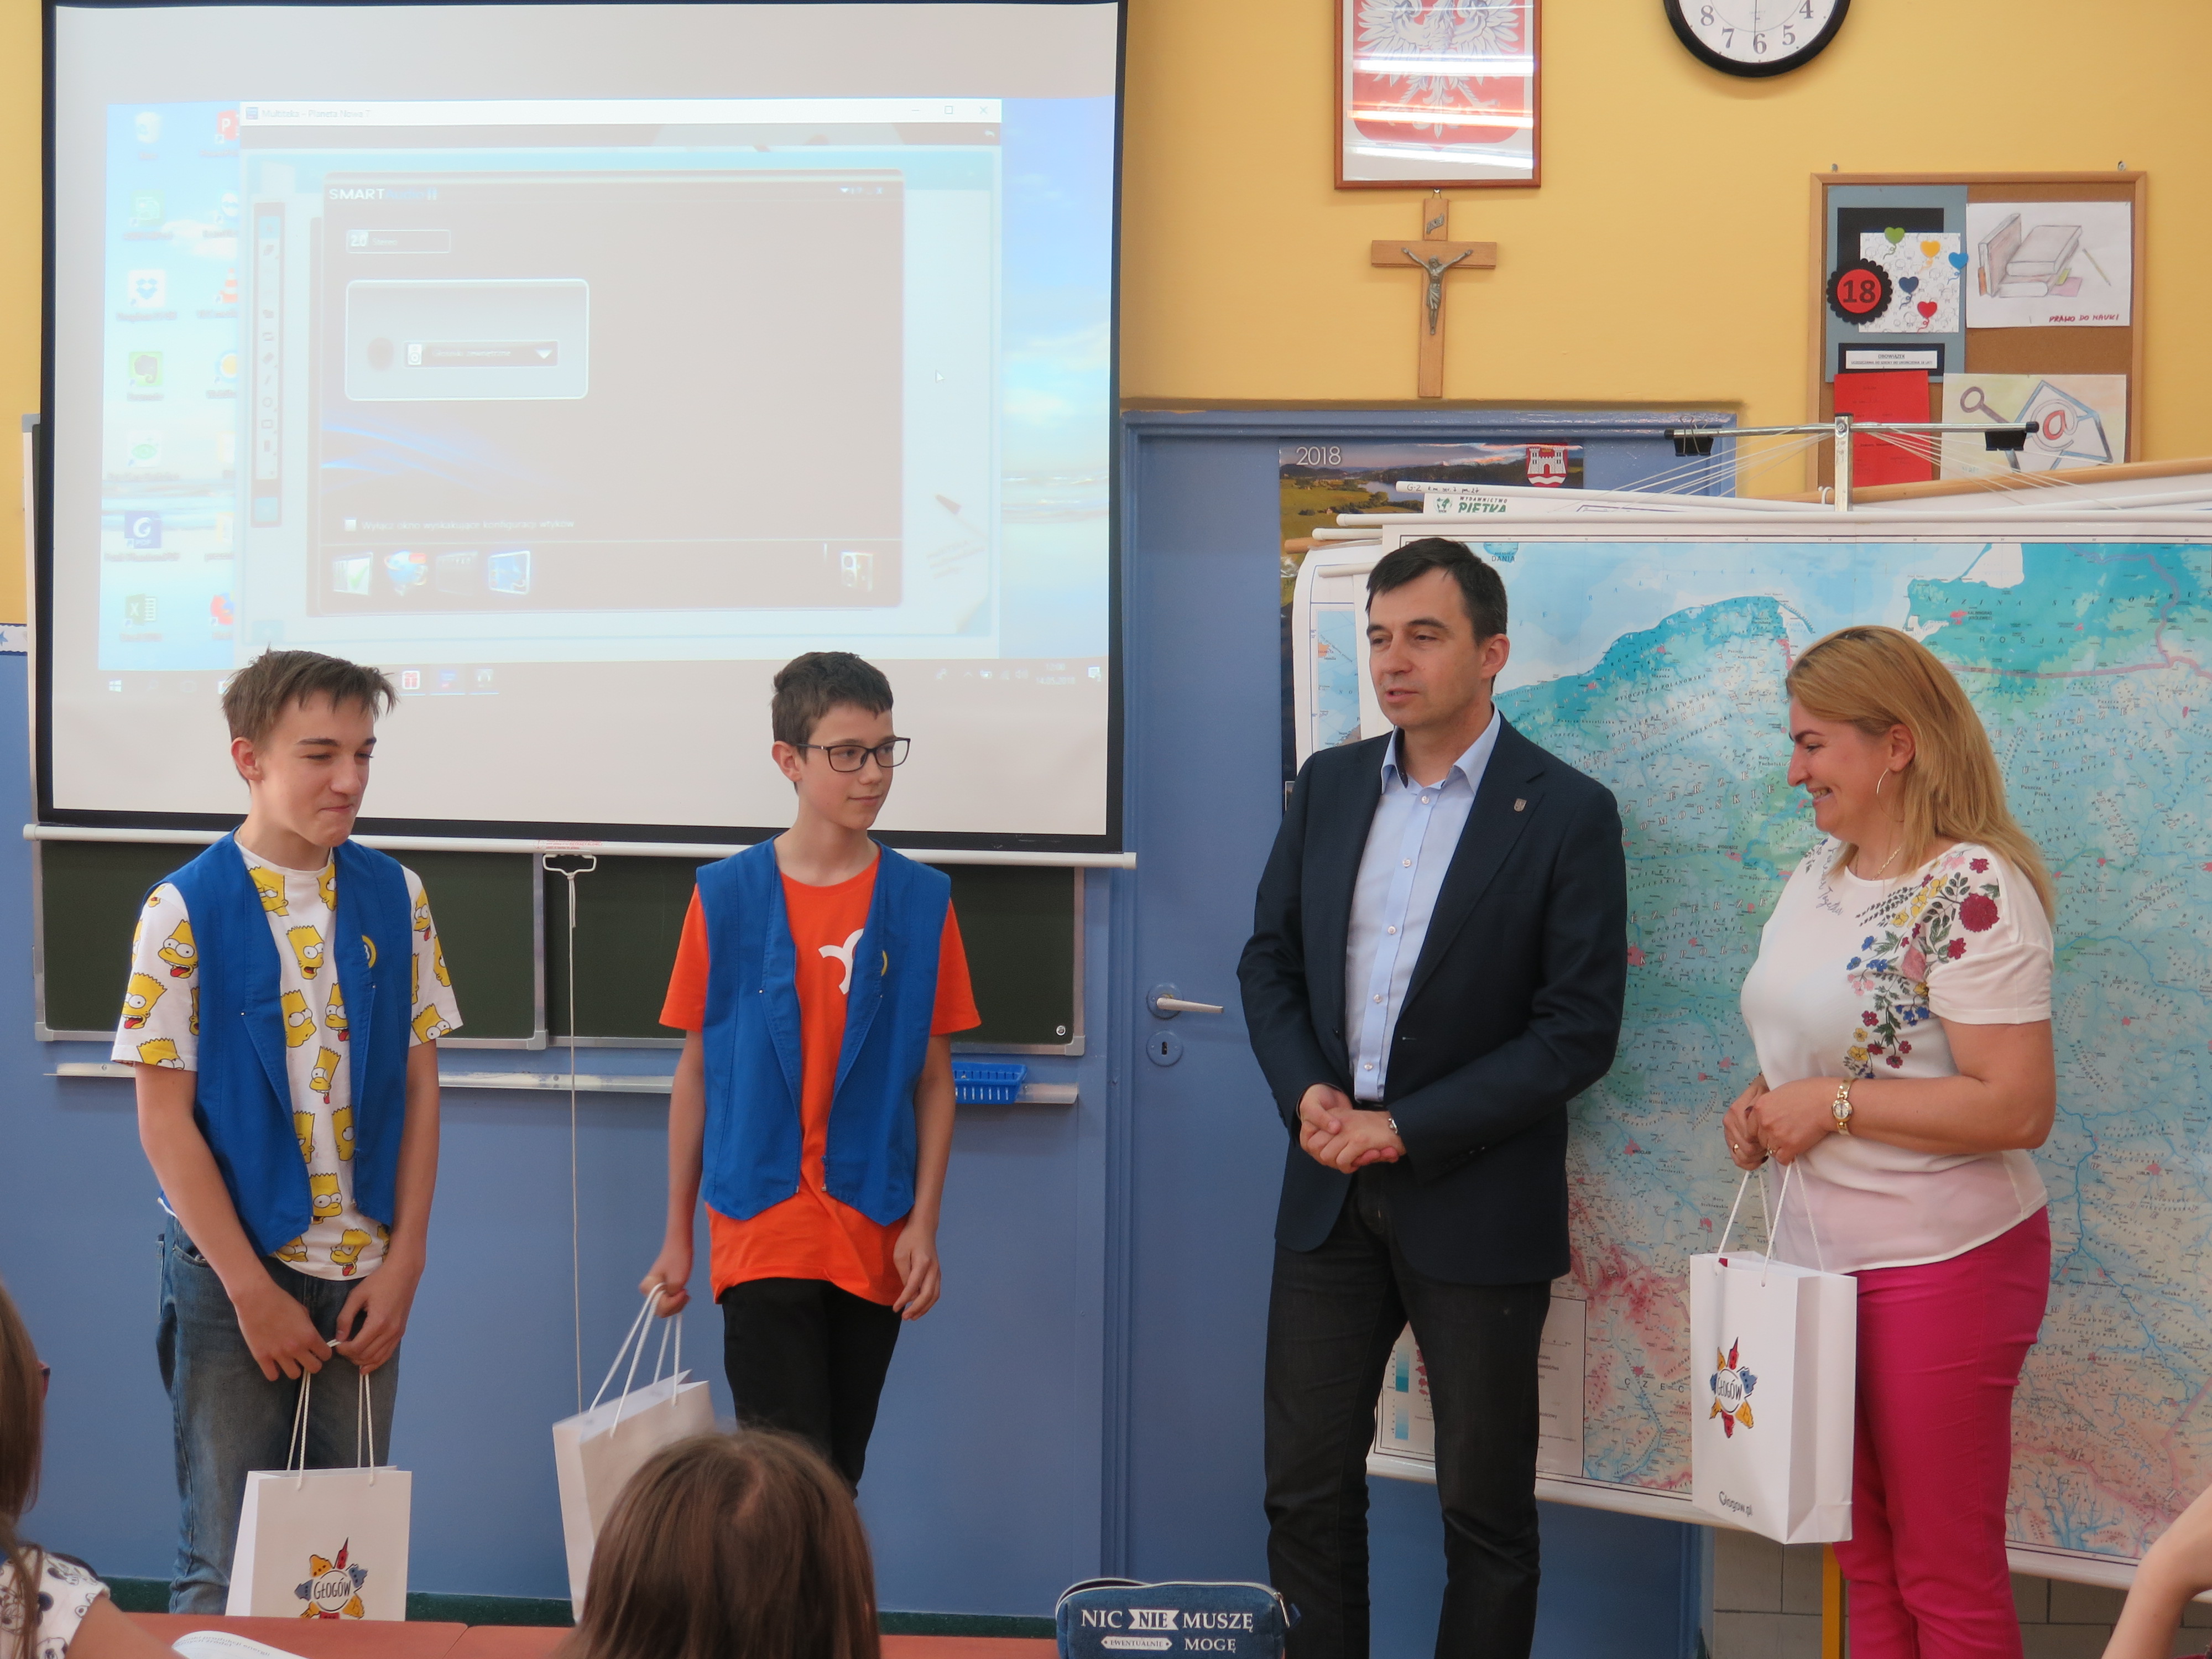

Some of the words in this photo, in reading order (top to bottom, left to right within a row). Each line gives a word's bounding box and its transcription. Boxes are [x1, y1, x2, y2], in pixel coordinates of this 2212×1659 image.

[1700, 6, 1714, 26] 8
[1721, 27, 1734, 48] 7
[1754, 33, 1767, 54] 6
[1782, 24, 1795, 45] 5
[328, 188, 385, 200] SMART
[1843, 280, 1876, 304] 18
[1296, 446, 1342, 466] 2018
[397, 521, 421, 530] okno
[1717, 1377, 1743, 1401] GŁOGÓW
[313, 1577, 352, 1600] GŁOGÓW
[1081, 1609, 1123, 1629] NIC
[1138, 1611, 1168, 1629] NIE
[1182, 1613, 1254, 1632] MUSZĘ
[1110, 1640, 1164, 1648] EWENTUALNIE
[1185, 1638, 1236, 1653] MOGĘ
